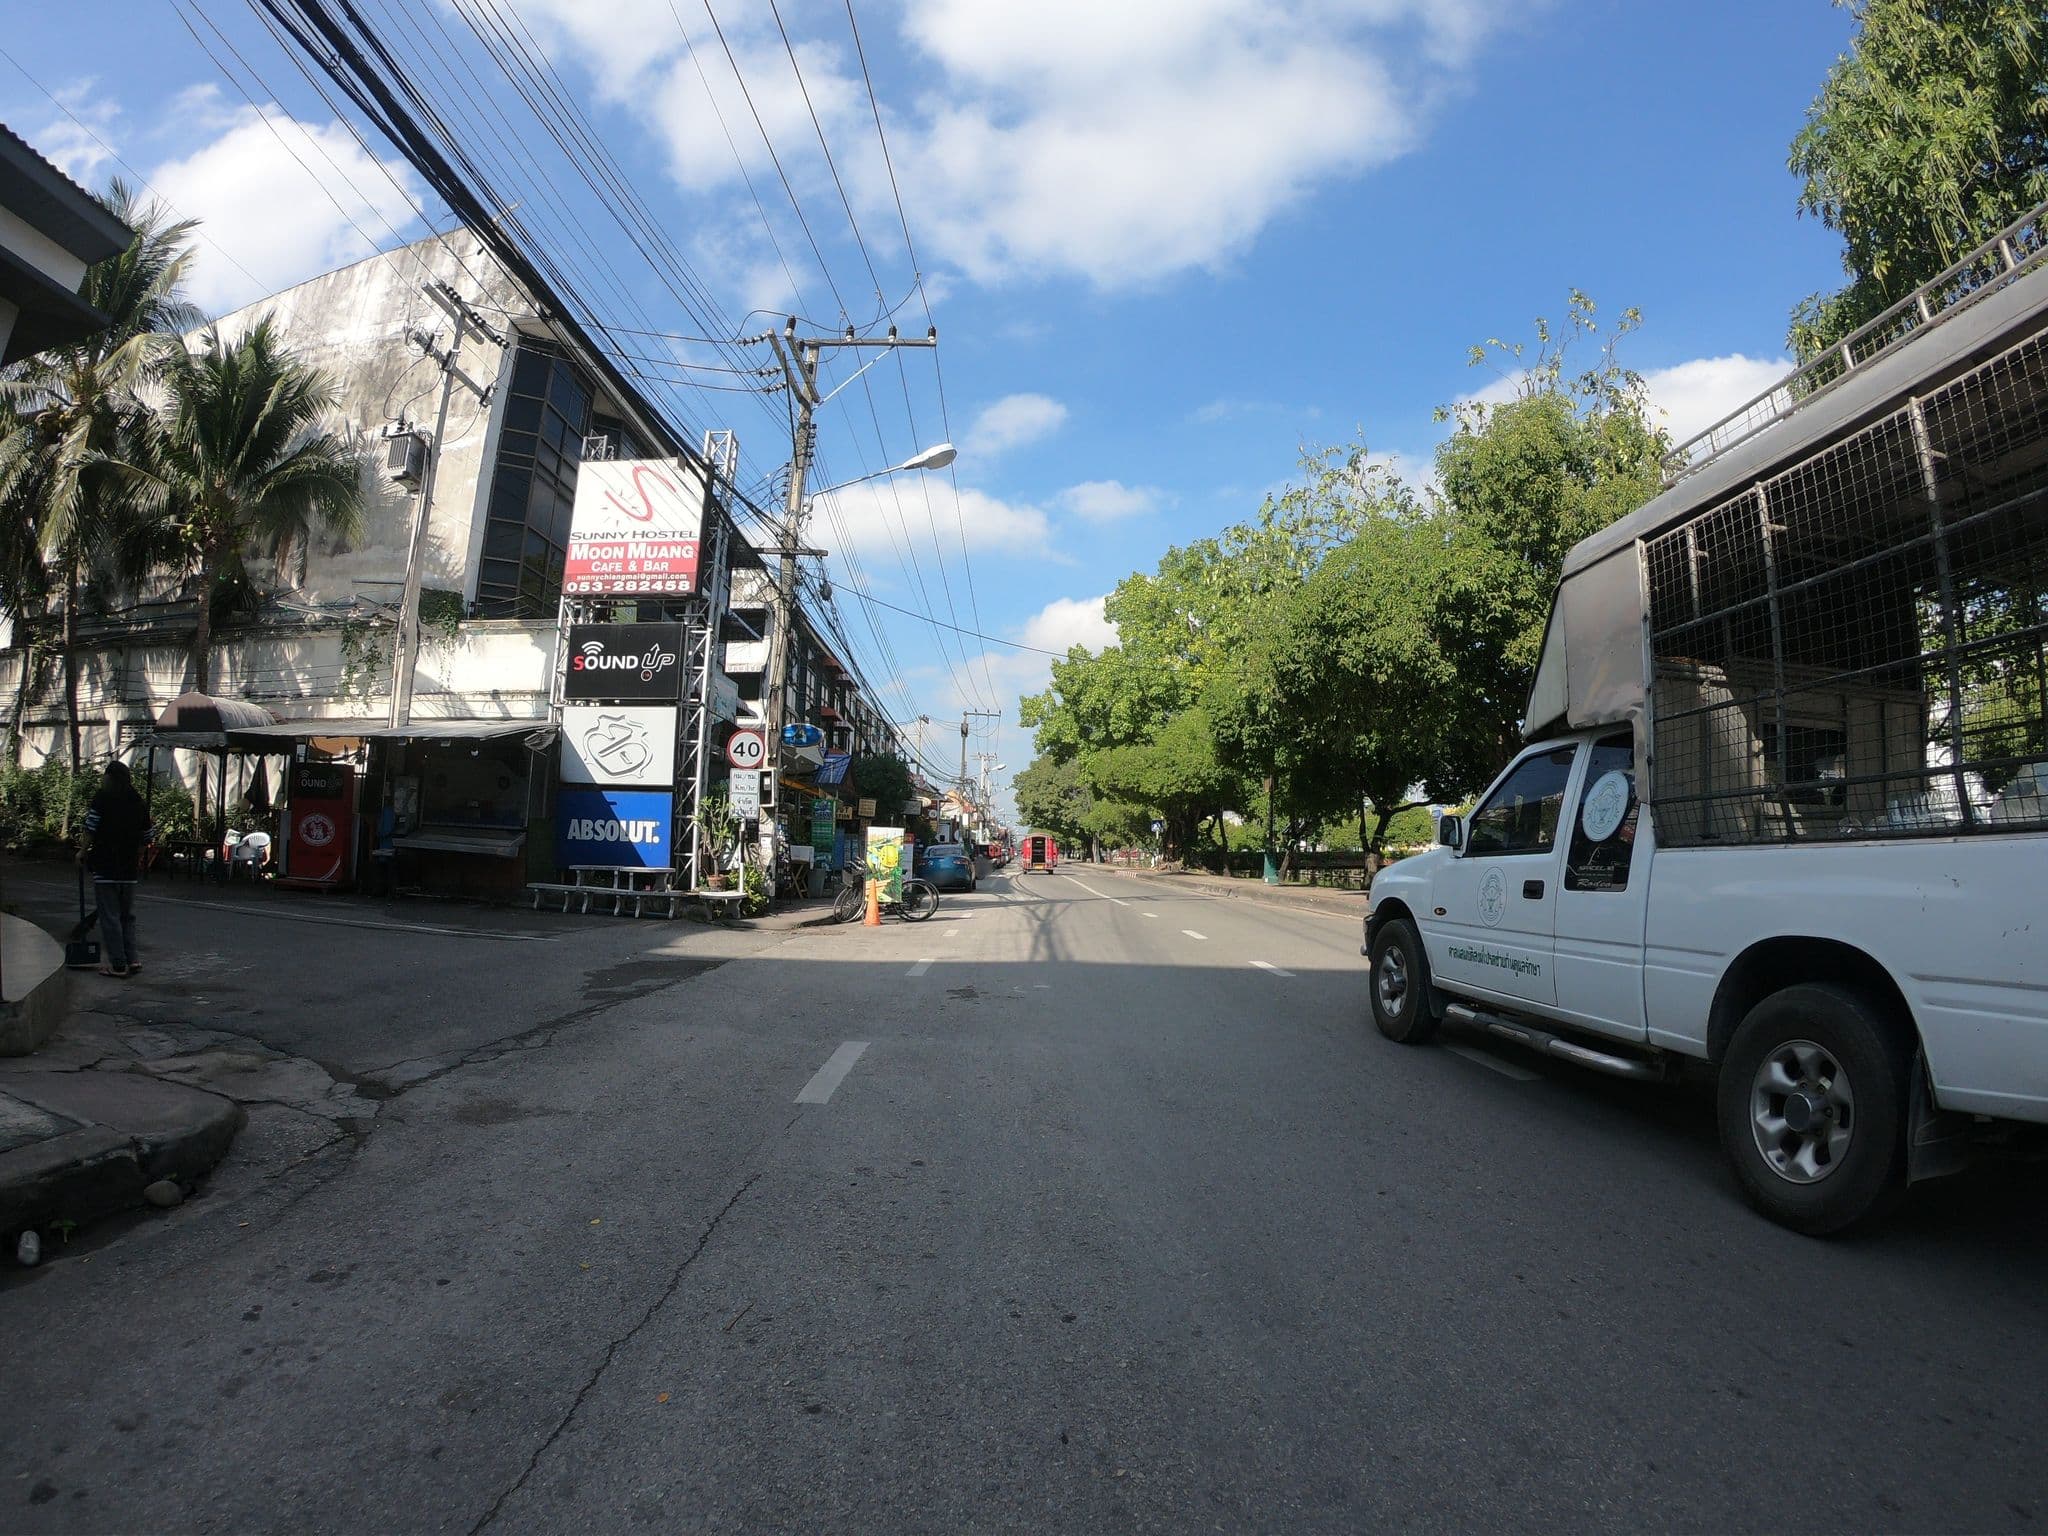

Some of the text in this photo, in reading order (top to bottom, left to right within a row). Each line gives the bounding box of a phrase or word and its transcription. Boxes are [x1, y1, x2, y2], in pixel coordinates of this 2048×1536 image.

[571, 530, 698, 540] SUNNY HOSTEL
[571, 542, 694, 560] MOON MUANG
[591, 560, 669, 572] CAFE & BAR
[566, 580, 690, 592] 053-282458
[573, 655, 639, 671] SOUND
[733, 741, 760, 757] 40
